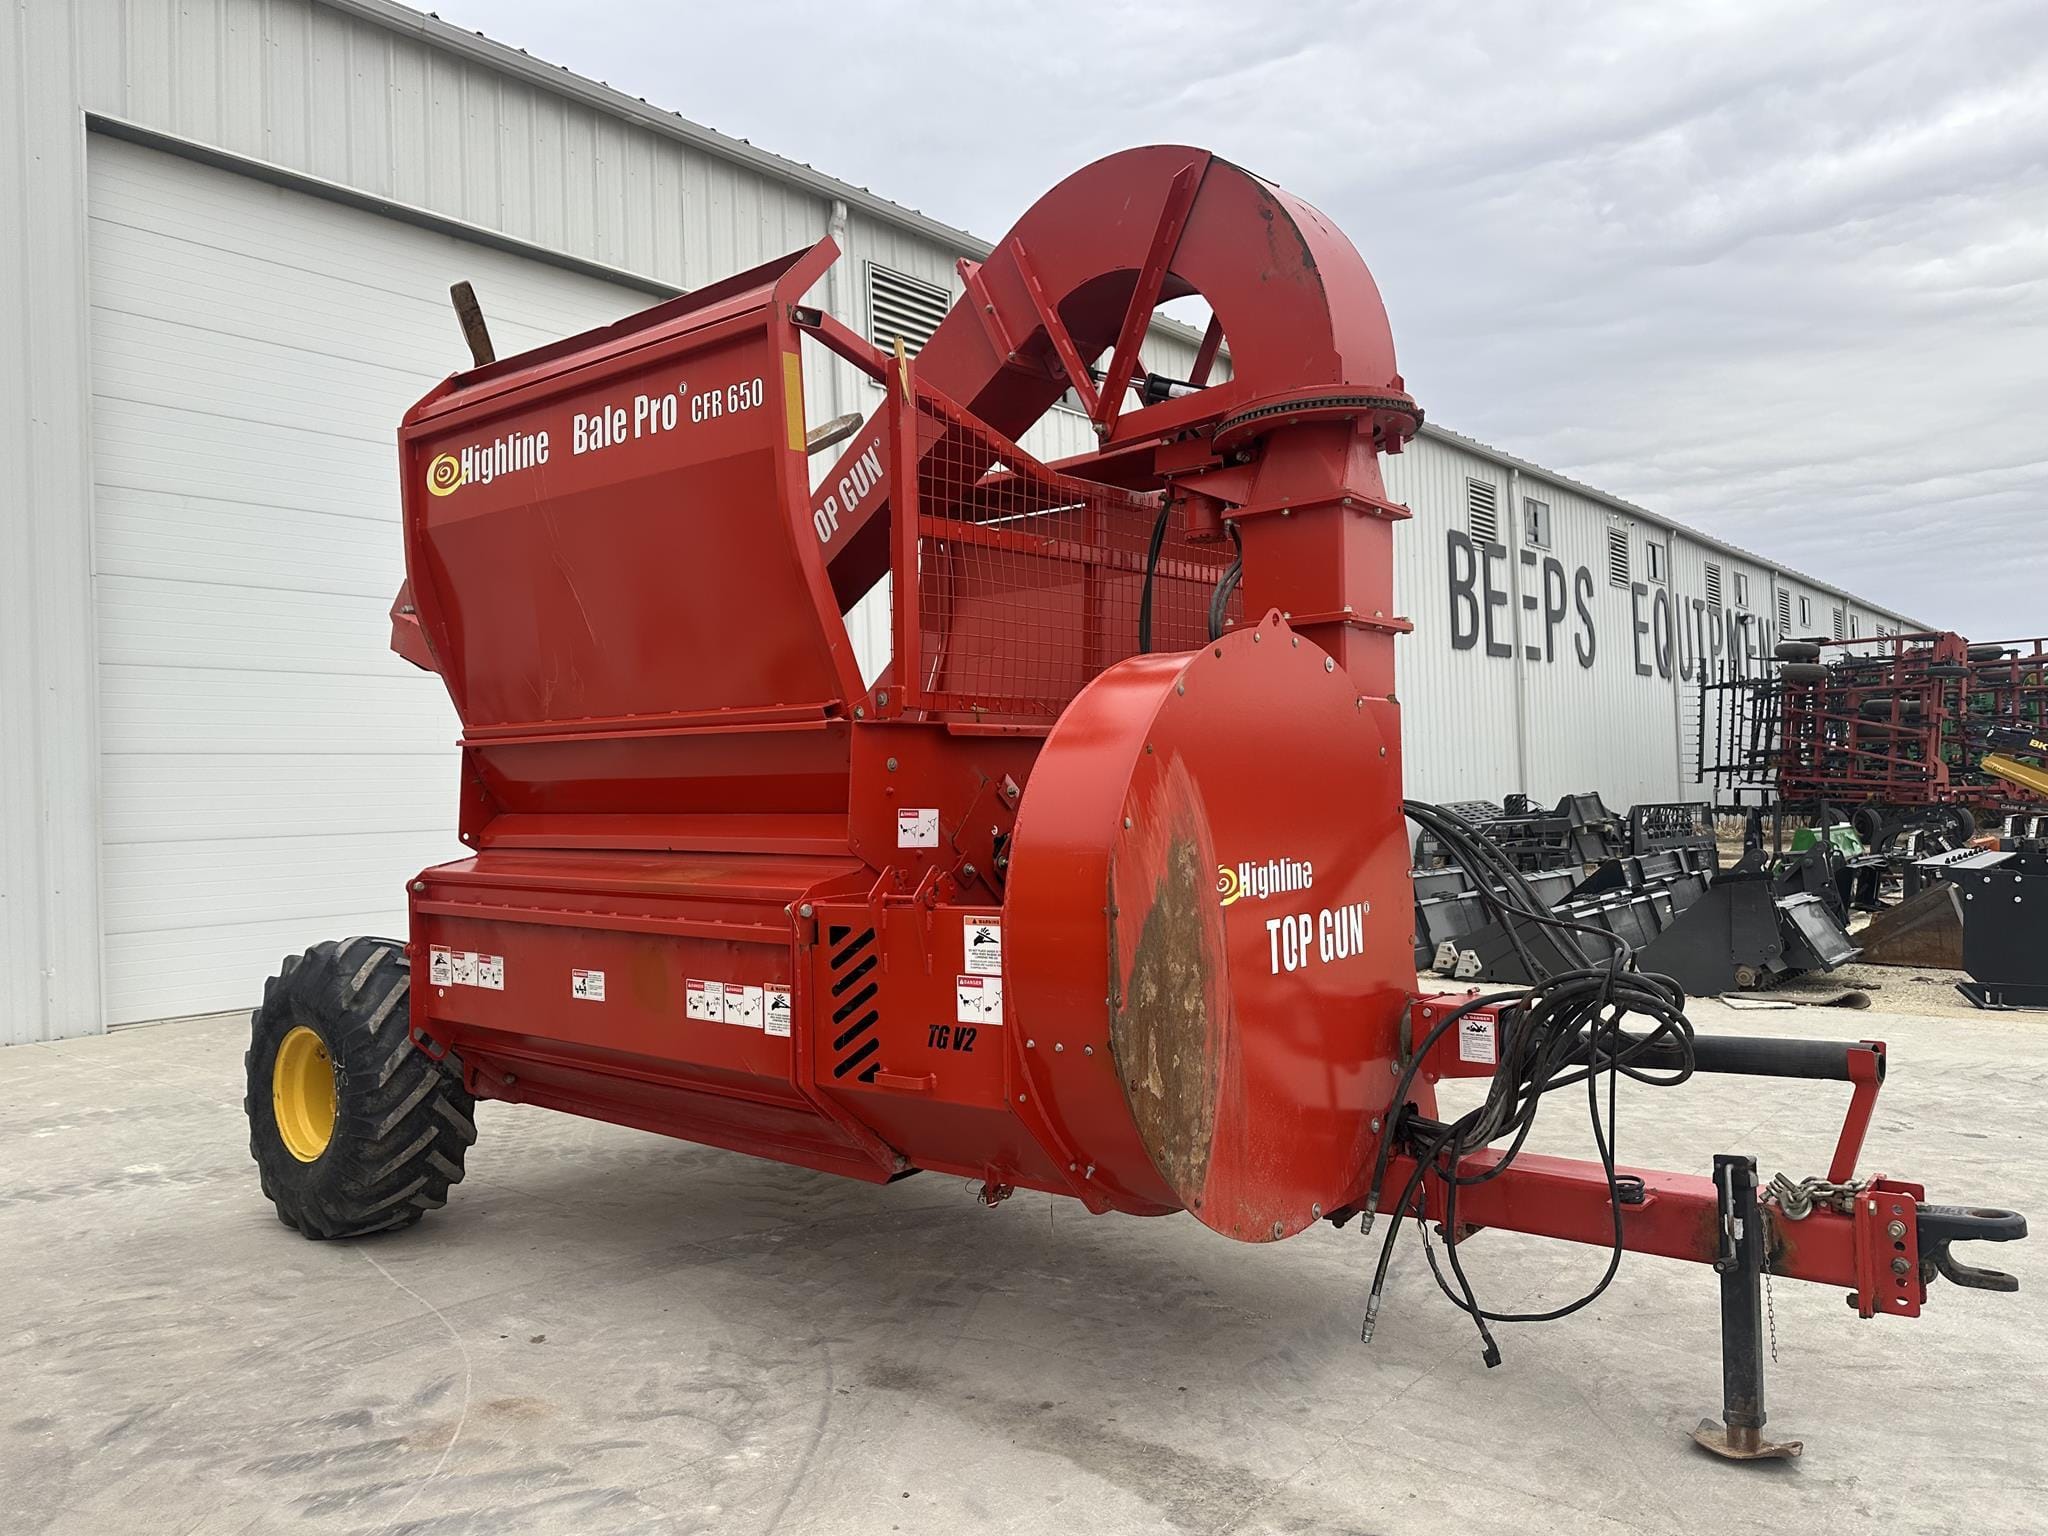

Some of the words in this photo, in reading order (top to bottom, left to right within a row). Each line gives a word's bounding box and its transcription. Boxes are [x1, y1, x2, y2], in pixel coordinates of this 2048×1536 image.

[461, 431, 549, 486] Highline
[573, 405, 627, 455] Bale
[691, 389, 722, 423] CFR
[727, 377, 763, 413] 650
[814, 496, 839, 543] OP
[839, 445, 884, 513] GUN
[1447, 529, 1596, 669] BEEPS
[1238, 857, 1313, 899] Highline
[1266, 913, 1313, 975] TOP
[1319, 903, 1364, 963] GUN
[928, 1024, 951, 1050] TG
[953, 1026, 977, 1052] V2
